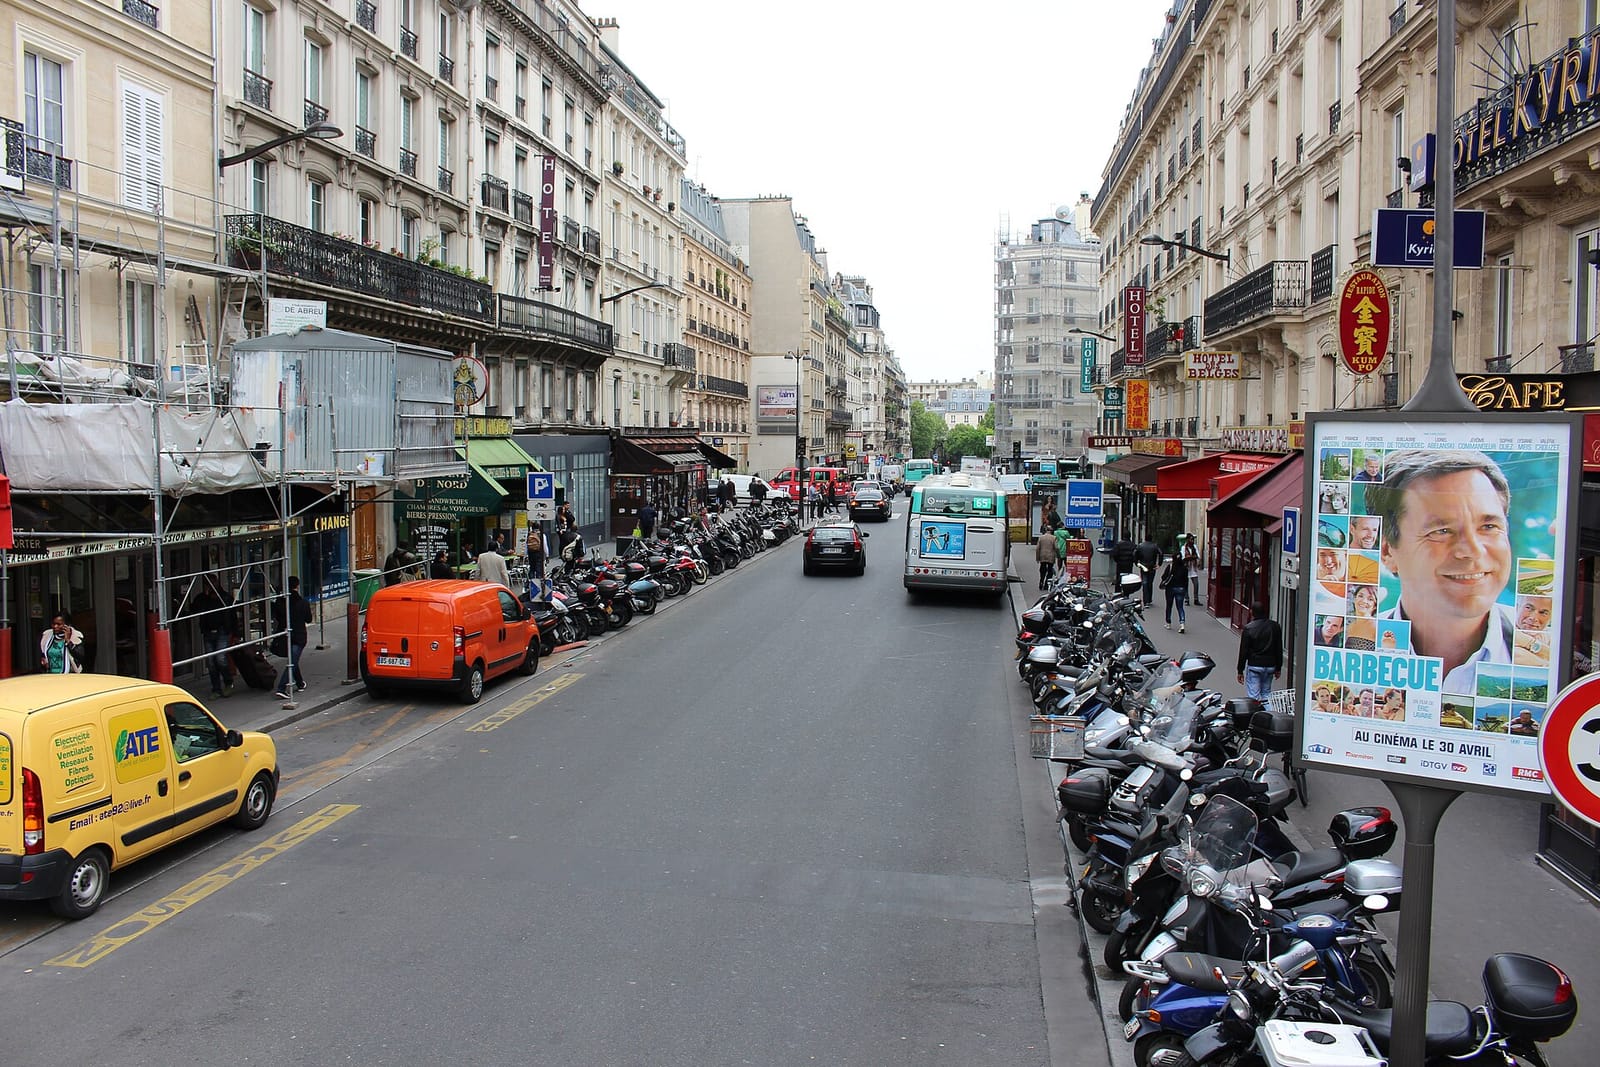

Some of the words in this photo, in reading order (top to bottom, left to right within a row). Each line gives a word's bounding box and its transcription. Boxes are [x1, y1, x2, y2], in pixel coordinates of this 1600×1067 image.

[1513, 33, 1600, 139] KYRI
[541, 159, 554, 267] HOTEL
[1408, 243, 1434, 256] Kyri
[1345, 273, 1386, 299] RESTAURATION
[1356, 286, 1376, 294] RAPIDE
[285, 306, 295, 314] DE
[298, 307, 323, 315] ABREU
[1129, 290, 1141, 351] HOTEL
[1084, 341, 1092, 383] HOTEL
[1193, 354, 1234, 363] HOTEL
[1205, 361, 1220, 369] DES
[1188, 368, 1239, 378] BELGES
[1094, 438, 1131, 446] HOTEL
[535, 478, 548, 494] P
[428, 512, 457, 520] PRESSION
[450, 505, 488, 513] VOYAGEURS
[1286, 517, 1293, 545] P
[14, 539, 40, 549] ORTER
[66, 545, 82, 555] TAKE
[85, 543, 103, 553] AWAY
[118, 536, 146, 549] BIERES
[191, 530, 216, 540] AMSTEL
[1314, 648, 1440, 692] BARBECUE
[55, 731, 90, 747] Electricité
[124, 726, 160, 760] ATE
[1355, 731, 1369, 742] AU
[1374, 732, 1418, 748] CINÉMA
[1423, 739, 1435, 750] LE
[1440, 741, 1454, 753] 30
[1459, 744, 1492, 757] AVRIL
[57, 745, 94, 760] Ventilation
[60, 757, 88, 769] Réseaux
[68, 765, 89, 776] Fibres
[1420, 760, 1448, 770] iDTGV
[1518, 769, 1538, 778] RMC
[65, 773, 95, 787] Optiques
[70, 814, 94, 830] Email
[99, 794, 151, 820] ate92@live.fr
